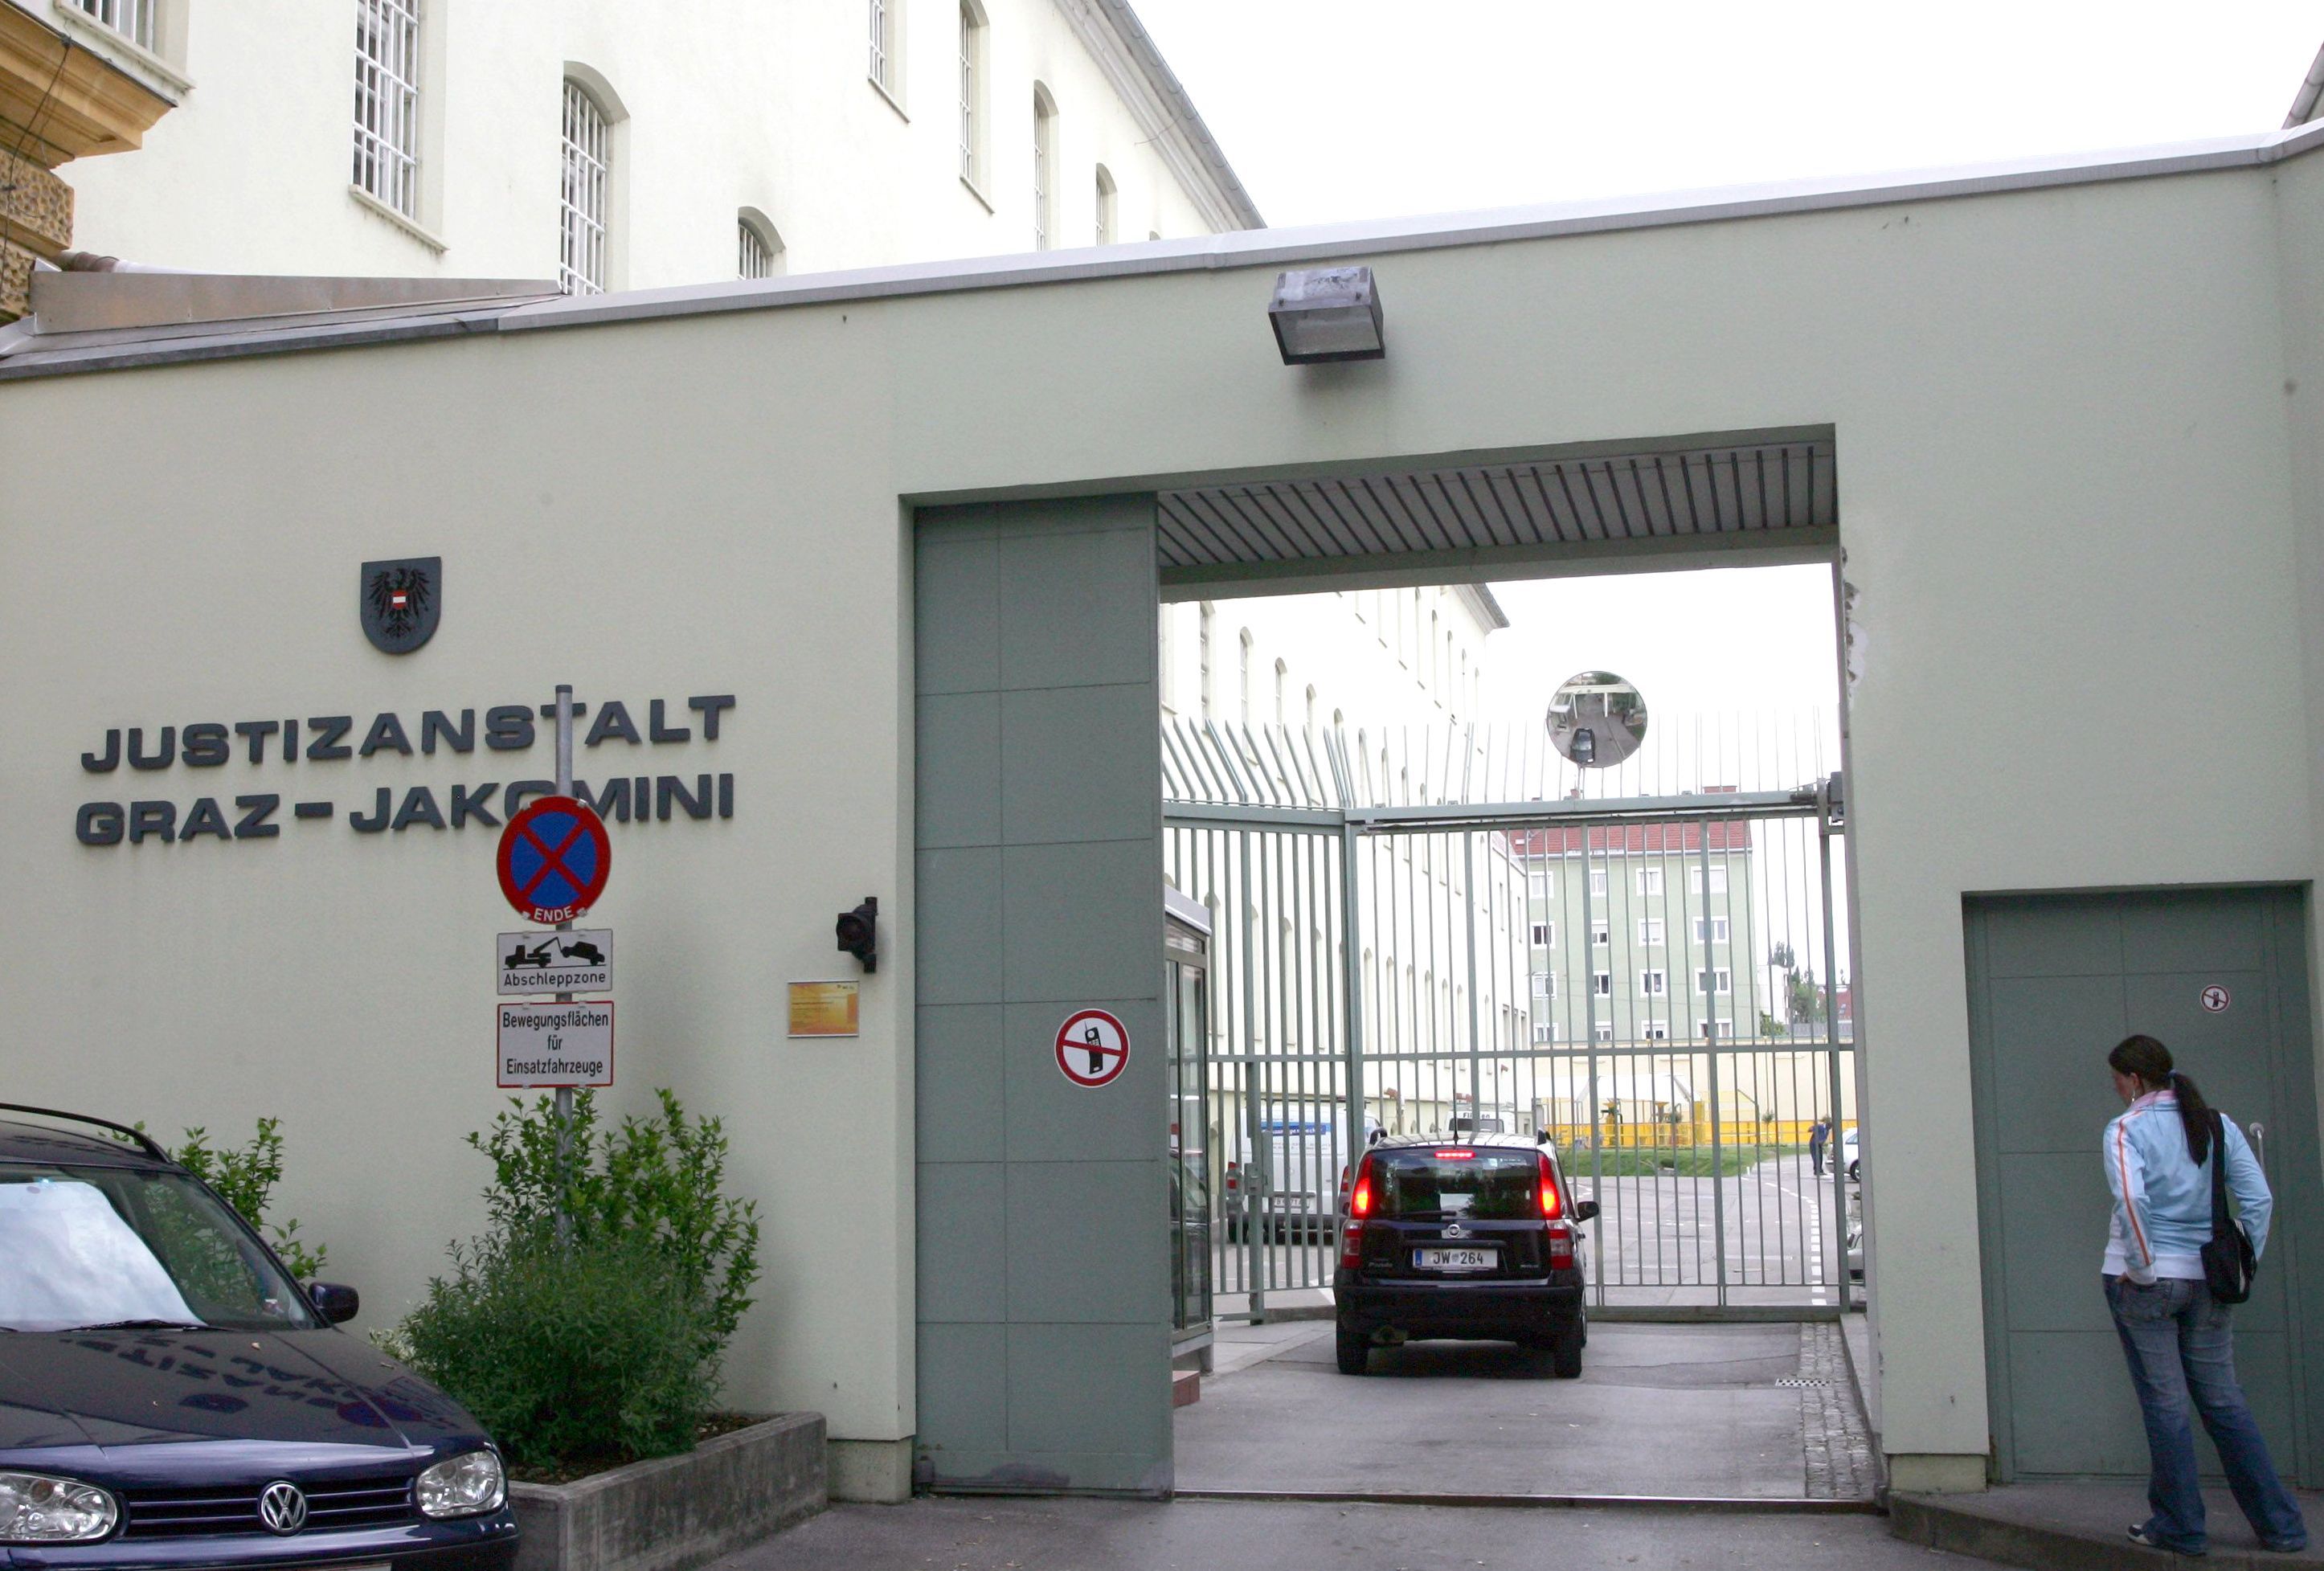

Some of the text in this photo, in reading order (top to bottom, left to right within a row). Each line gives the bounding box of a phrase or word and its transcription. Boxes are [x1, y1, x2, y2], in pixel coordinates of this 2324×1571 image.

[534, 906, 574, 922] ENDE
[504, 972, 606, 988] Abschleppzone
[502, 1010, 609, 1031] Bewegungsflächen
[547, 1034, 563, 1050] für
[506, 1058, 604, 1078] Einsatzfahrzeuge
[1433, 1252, 1483, 1264] JW 264
